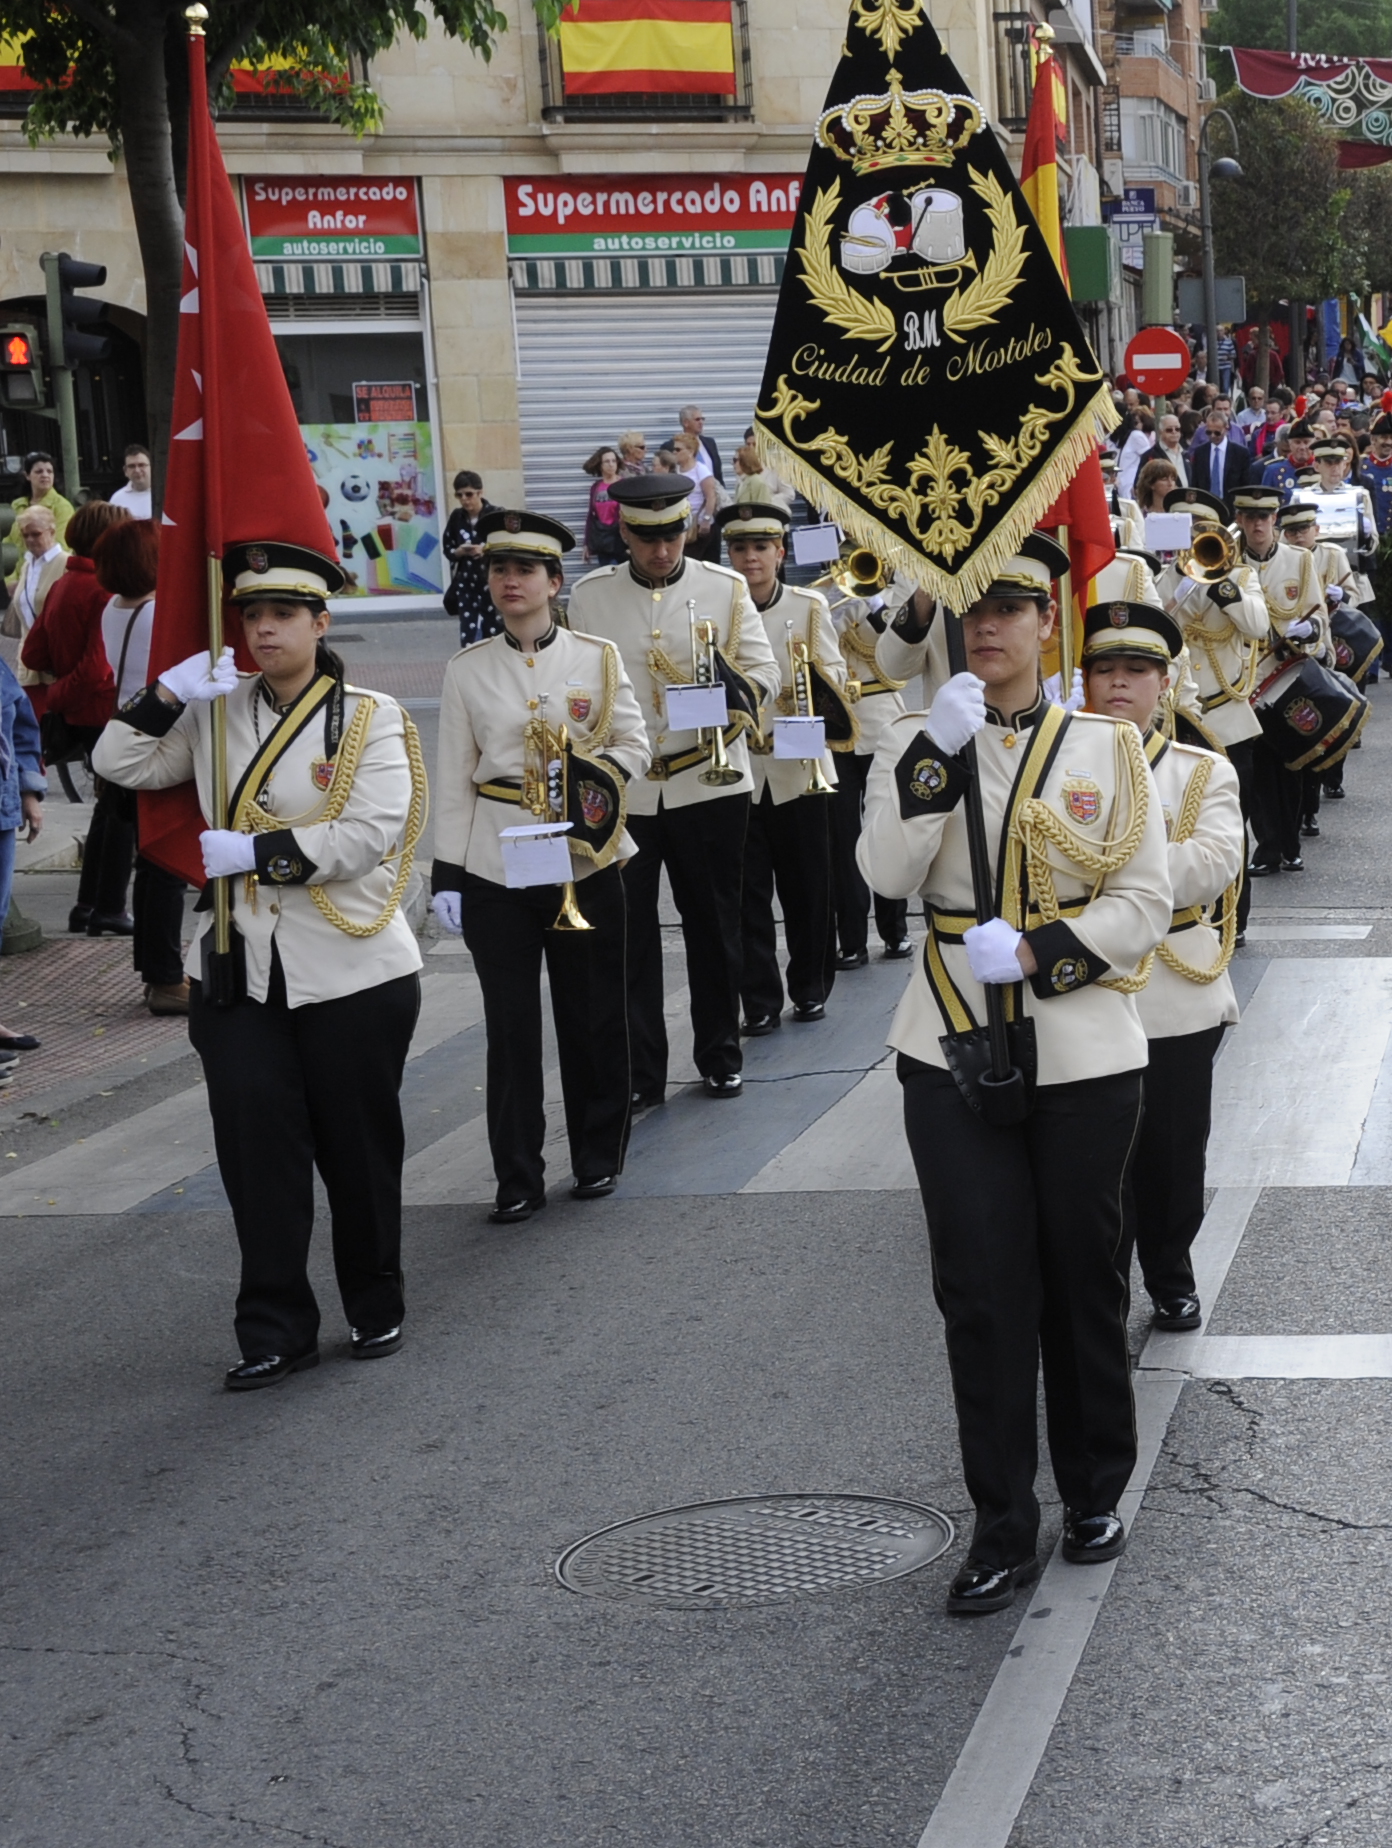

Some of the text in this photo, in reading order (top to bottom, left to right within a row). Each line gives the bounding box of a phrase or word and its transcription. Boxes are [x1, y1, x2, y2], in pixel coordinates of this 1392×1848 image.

[255, 183, 408, 206] Supermercado
[517, 182, 741, 224] Supermercado
[308, 210, 367, 229] Anfor
[283, 239, 385, 255] autoservicio
[592, 233, 736, 251] autoservicio
[903, 309, 941, 350] BM
[791, 322, 1052, 386] Ciudad de Mostoles
[751, 1517, 879, 1543] REGISTRO
